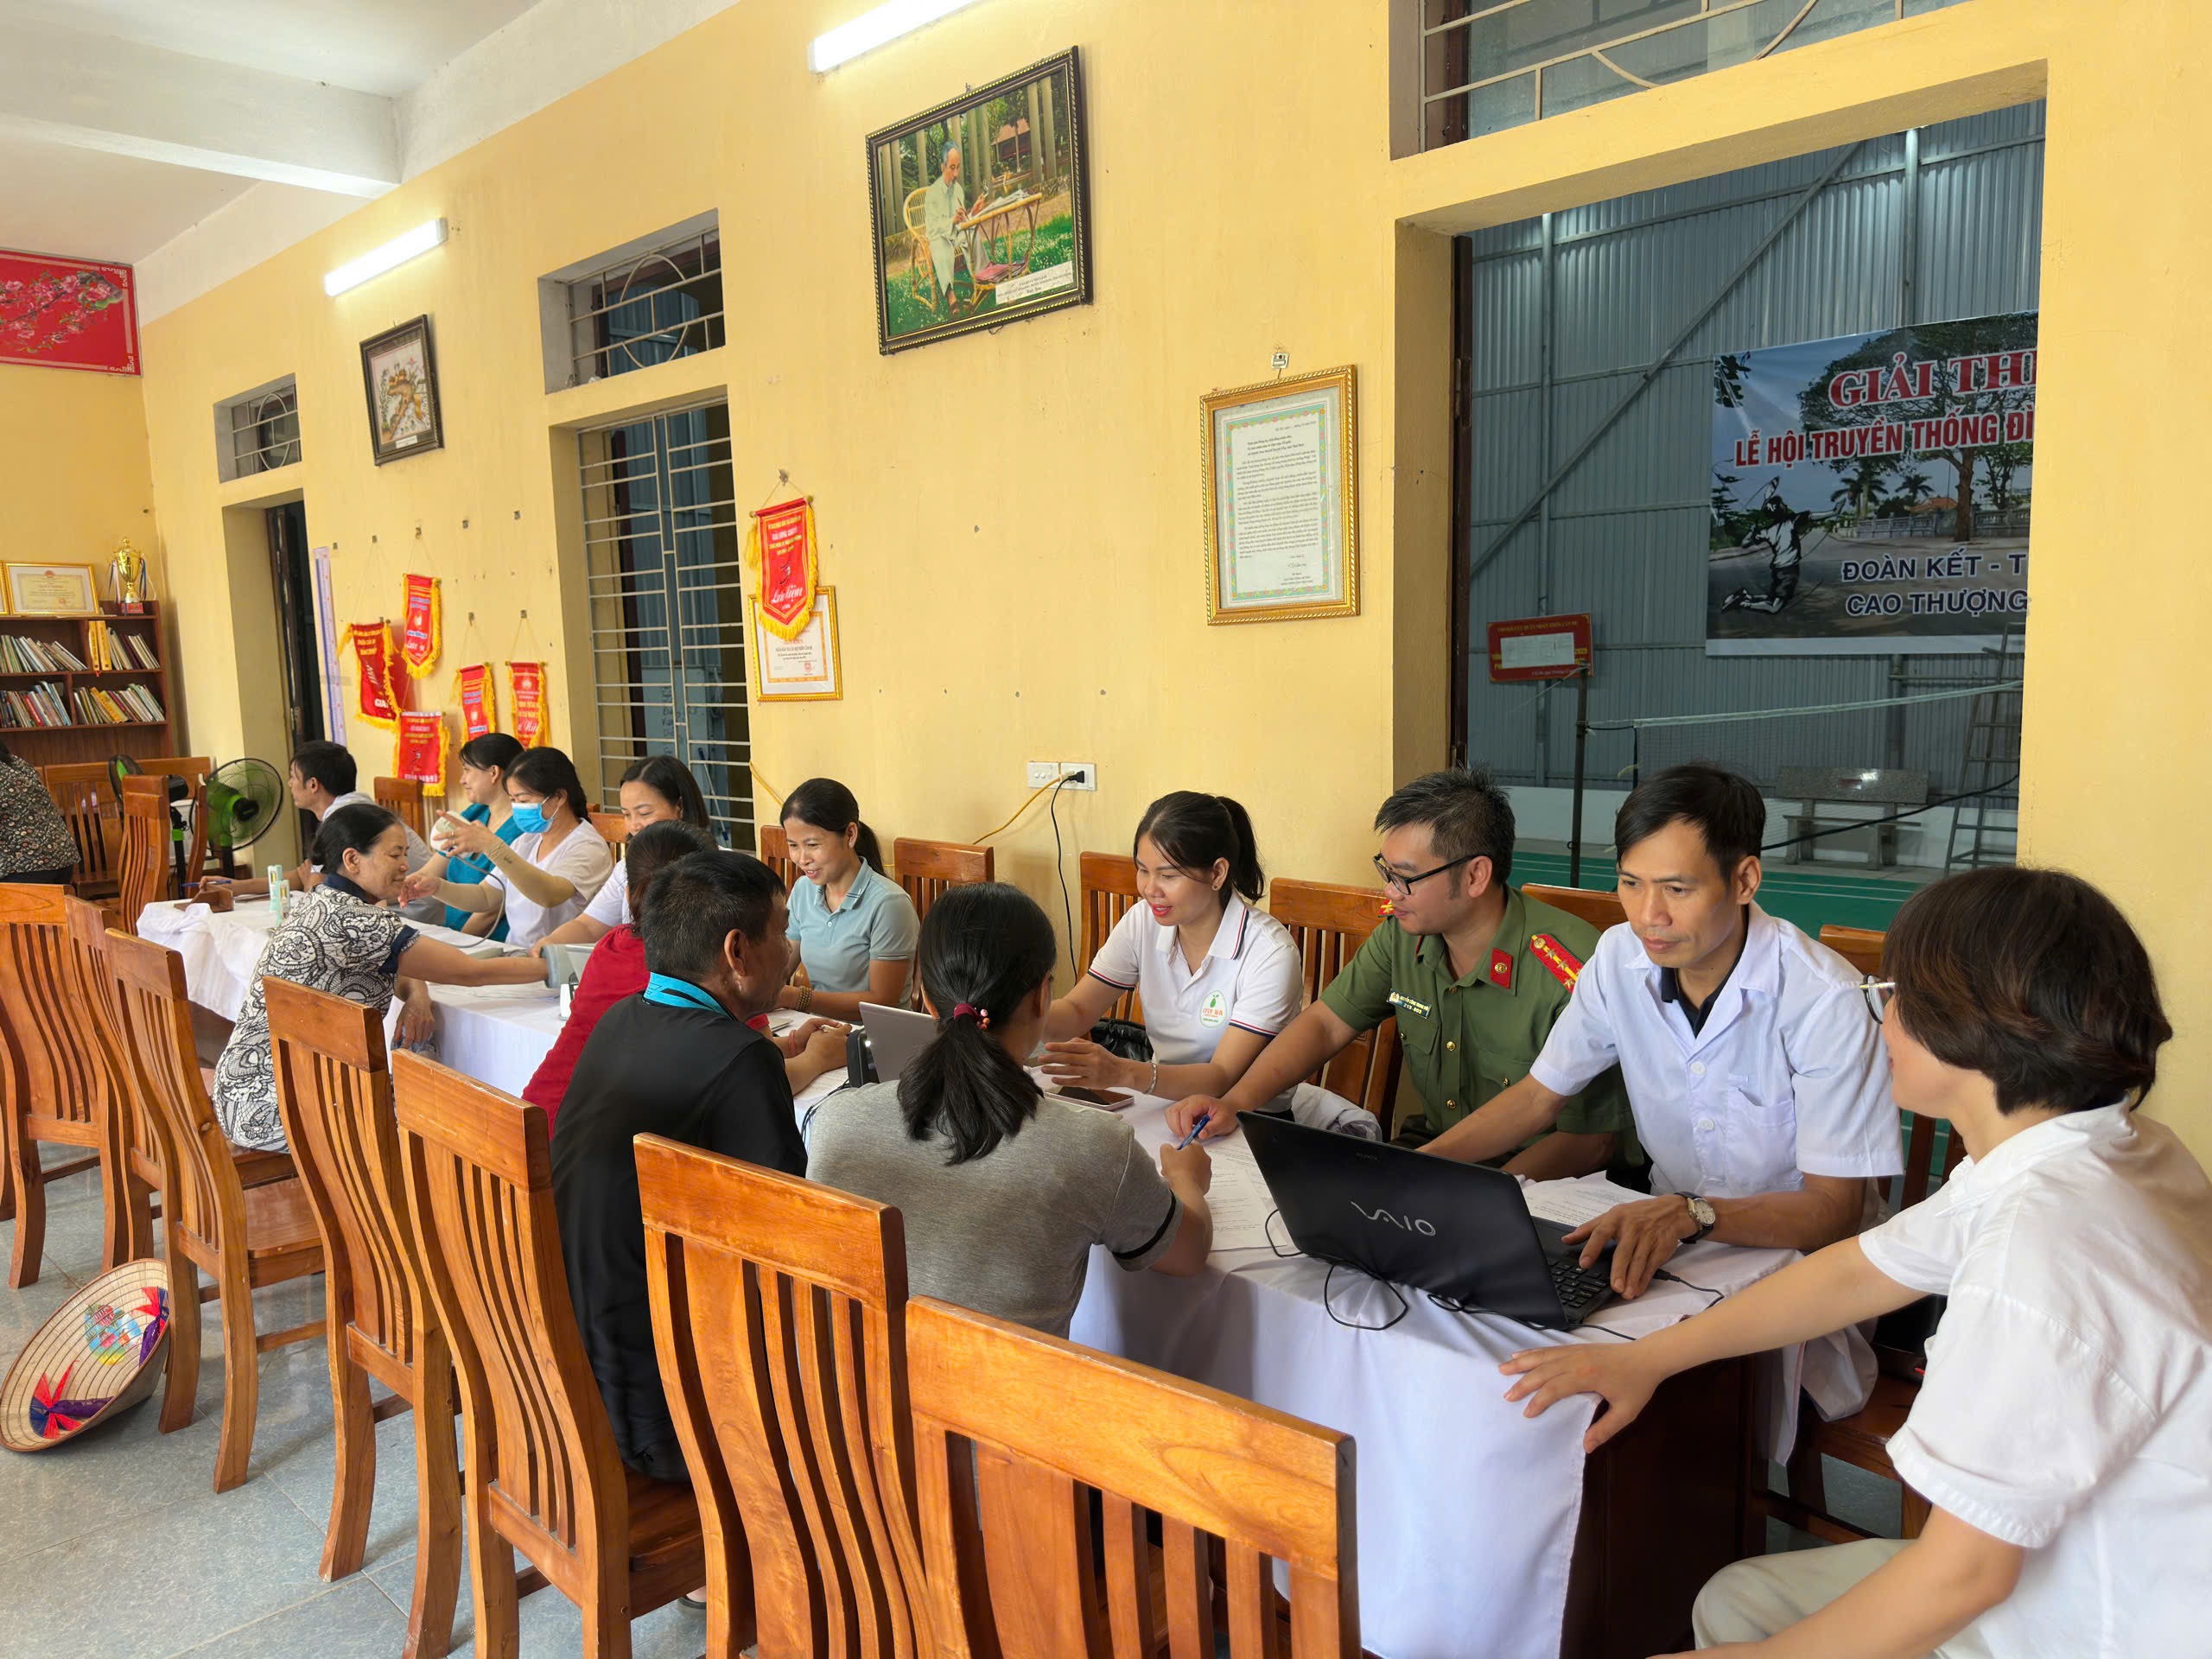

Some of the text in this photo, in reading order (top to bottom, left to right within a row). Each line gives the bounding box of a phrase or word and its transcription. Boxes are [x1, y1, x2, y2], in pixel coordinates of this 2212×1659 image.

[1829, 352, 1937, 408] GIẢI
[1735, 429, 1761, 467] LỄ
[1767, 429, 1806, 469] HỘI
[1811, 415, 1904, 461] TRUYỀN
[1912, 404, 1999, 450] THỐNG
[1842, 553, 1916, 582] ĐOÀN
[1925, 547, 1983, 578] KẾT
[1846, 588, 2028, 617] CAO THƯỢNG
[1351, 1201, 1436, 1236] VAIO
